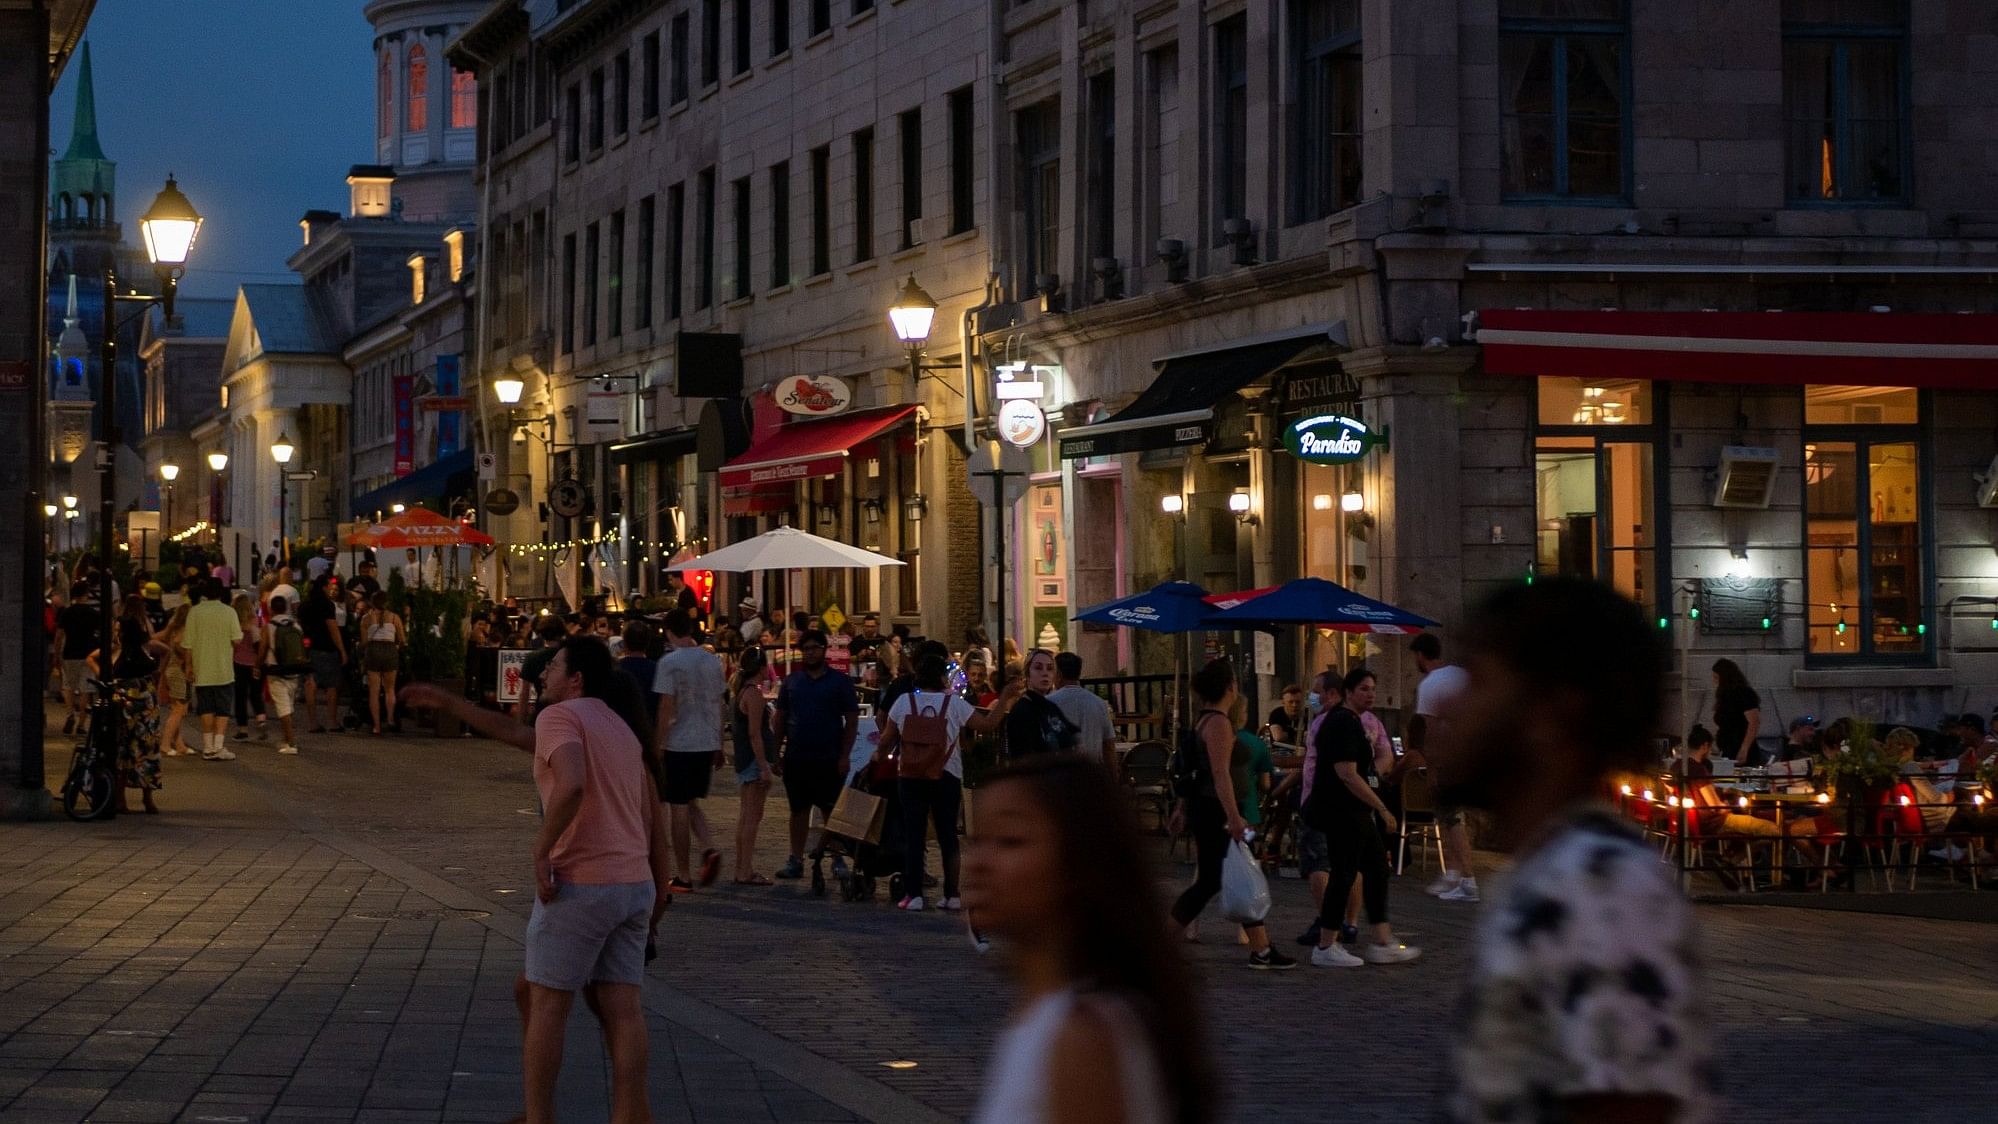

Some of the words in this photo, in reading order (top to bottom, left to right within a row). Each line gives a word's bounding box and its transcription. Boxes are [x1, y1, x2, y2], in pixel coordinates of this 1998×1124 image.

[1289, 372, 1360, 401] RESTAURAN
[1300, 428, 1362, 455] Paradiso
[395, 525, 461, 535] VIZZY
